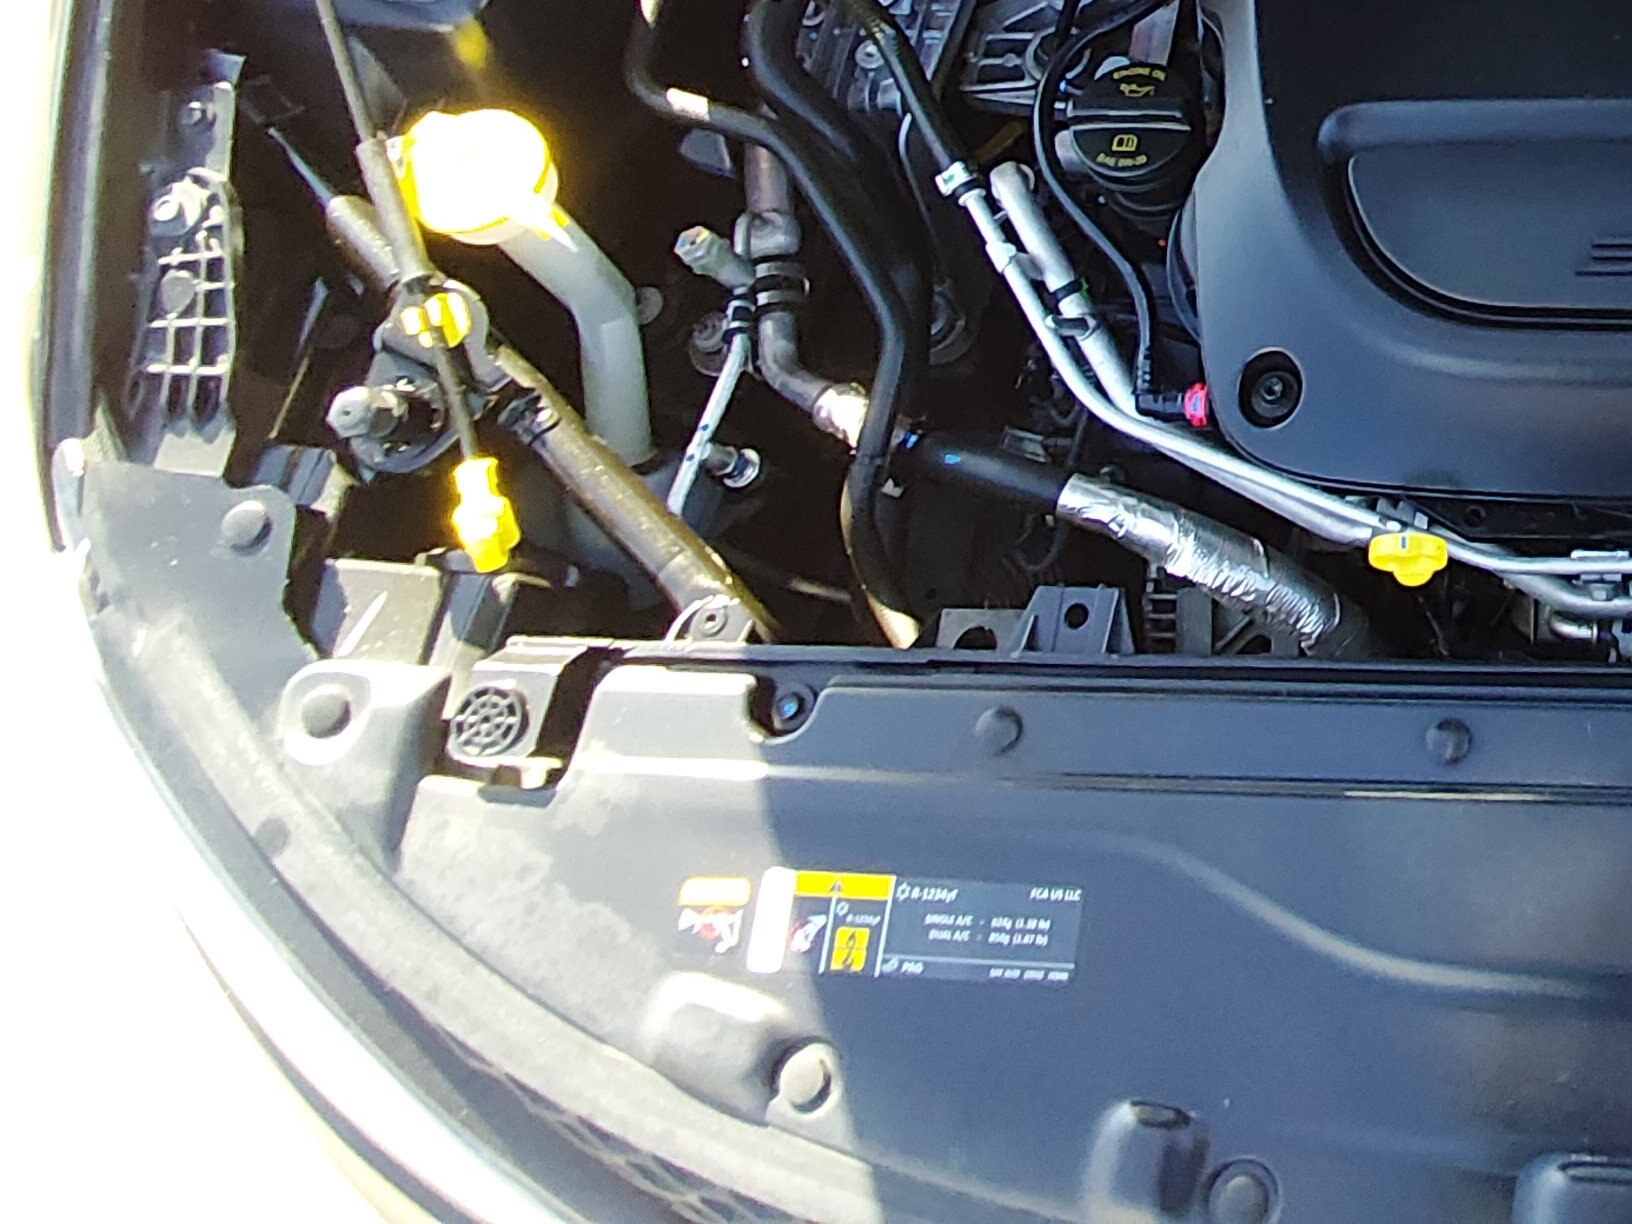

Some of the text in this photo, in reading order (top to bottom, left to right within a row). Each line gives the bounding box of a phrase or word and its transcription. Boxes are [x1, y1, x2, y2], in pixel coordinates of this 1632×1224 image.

[910, 885, 1083, 904] R-1234yf FCA US LLC
